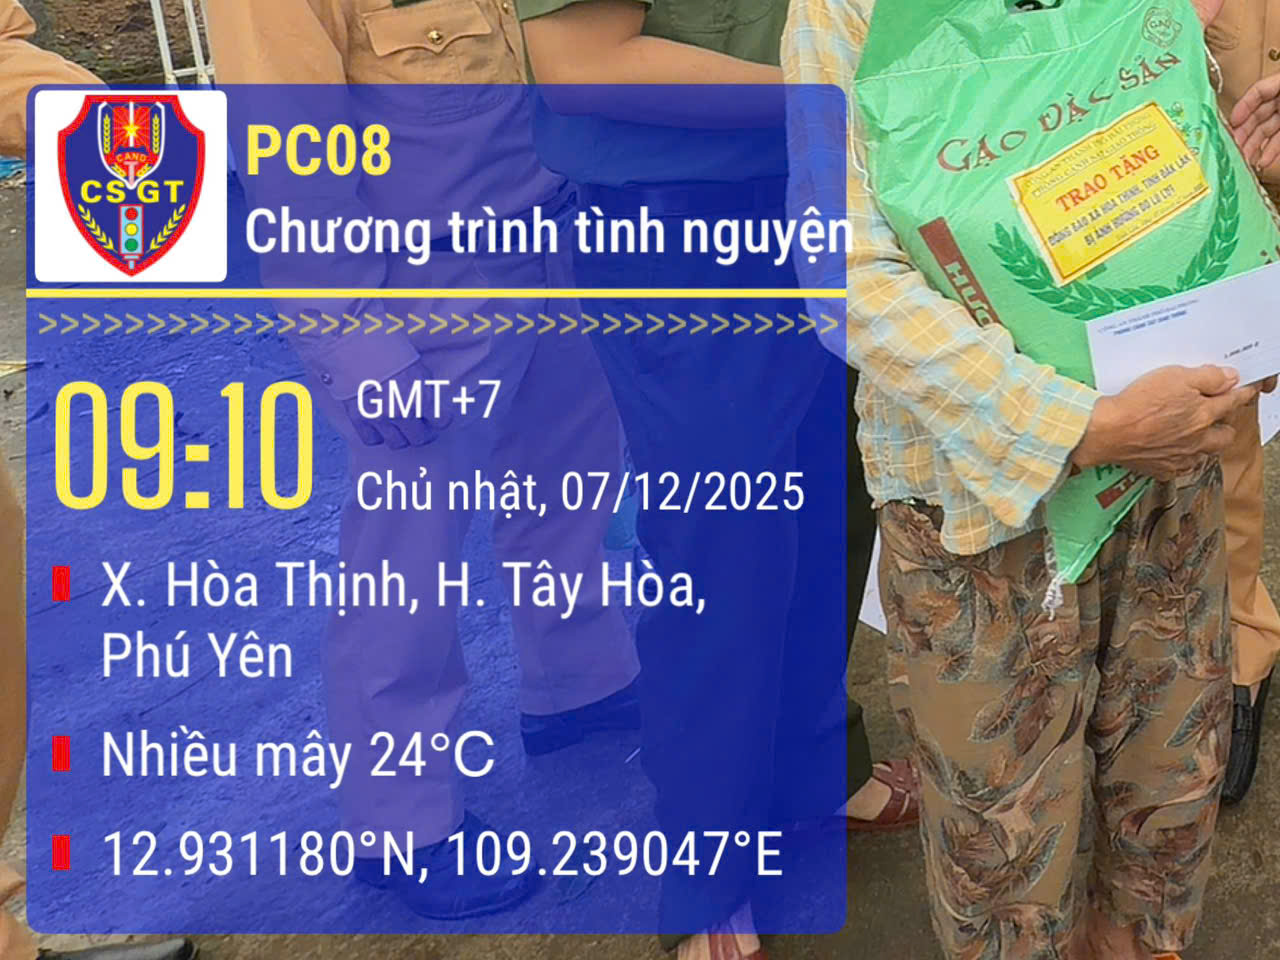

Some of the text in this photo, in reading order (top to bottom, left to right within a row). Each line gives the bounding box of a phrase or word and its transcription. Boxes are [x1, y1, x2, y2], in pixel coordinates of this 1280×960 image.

[937, 130, 1027, 172] GẠO
[1056, 172, 1108, 212] TRAO
[1109, 144, 1160, 181] TẶNG
